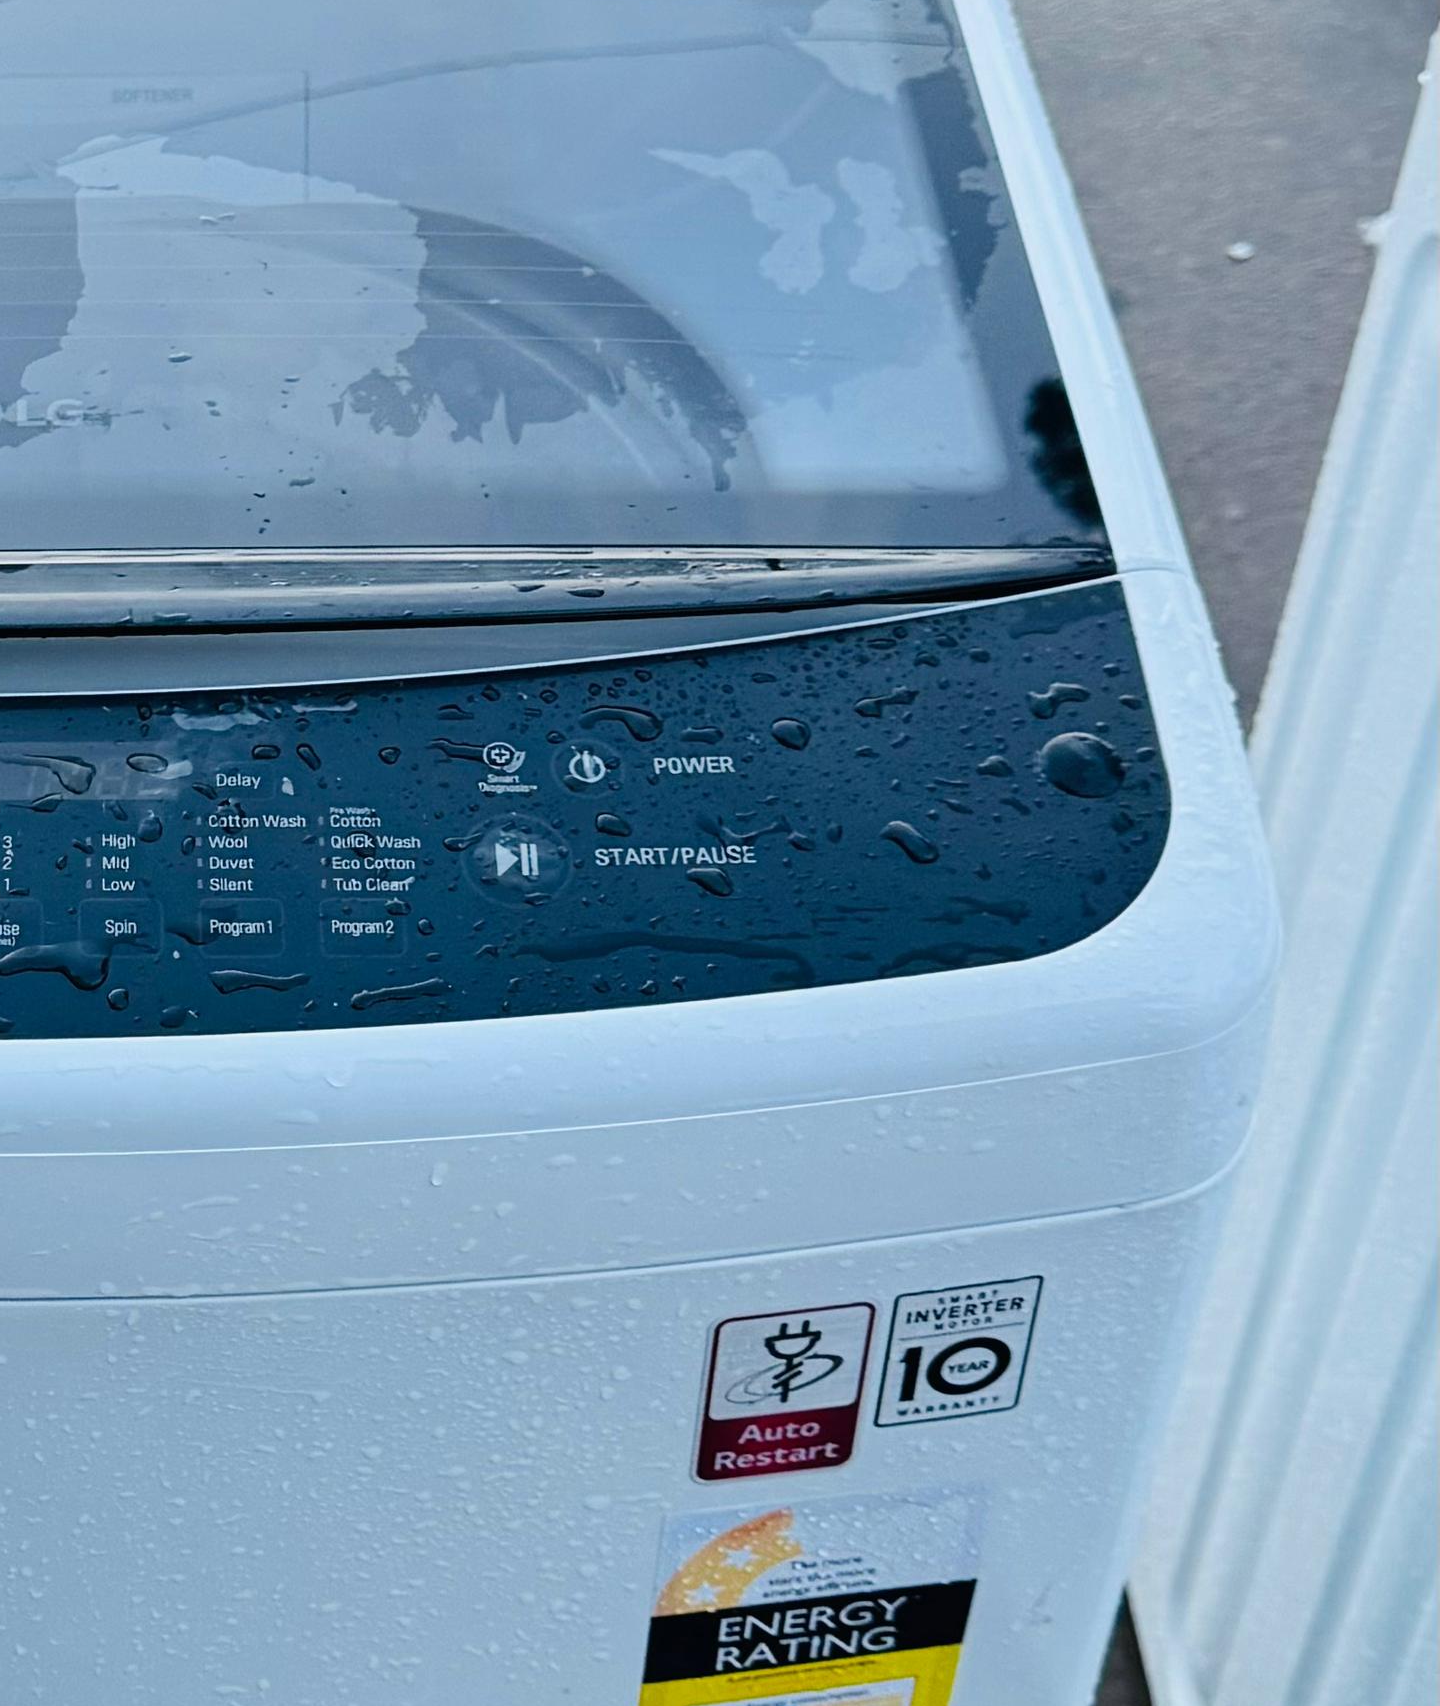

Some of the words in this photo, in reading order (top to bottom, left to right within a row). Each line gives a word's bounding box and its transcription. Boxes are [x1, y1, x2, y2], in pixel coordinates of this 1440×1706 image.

[112, 87, 194, 103] SOFTENER
[654, 756, 736, 775] POWER
[216, 774, 261, 789] Delay
[208, 815, 259, 828] Cotton
[262, 815, 306, 828] Wash
[330, 815, 381, 828] Cotton
[2, 836, 13, 849] 3
[102, 834, 135, 849] High
[209, 836, 248, 848] Wool
[330, 836, 375, 849] Quick
[377, 836, 421, 848] Wash
[102, 856, 129, 870] Mid
[595, 845, 758, 866] START/PAUSE
[2, 857, 12, 870] 2
[209, 857, 254, 870] Duvet
[332, 857, 360, 870] Eco
[364, 857, 415, 870] Cotton
[4, 878, 10, 891] 1
[102, 878, 135, 891] Low
[209, 878, 253, 891] Silent
[333, 878, 362, 891] Tub
[365, 878, 410, 891] Clean
[105, 919, 137, 936] Spin
[210, 920, 264, 936] Program
[332, 920, 383, 936] Program
[906, 1297, 1024, 1324] INVERTER
[934, 1316, 993, 1330] MOTOR
[898, 1337, 1012, 1402] 10
[946, 1359, 990, 1374] YEAR
[897, 1395, 1000, 1416] WARRANTY
[738, 1421, 820, 1444] Auto
[714, 1442, 840, 1471] Restart
[717, 1595, 907, 1643] ENERGY
[715, 1626, 898, 1672] RATING
